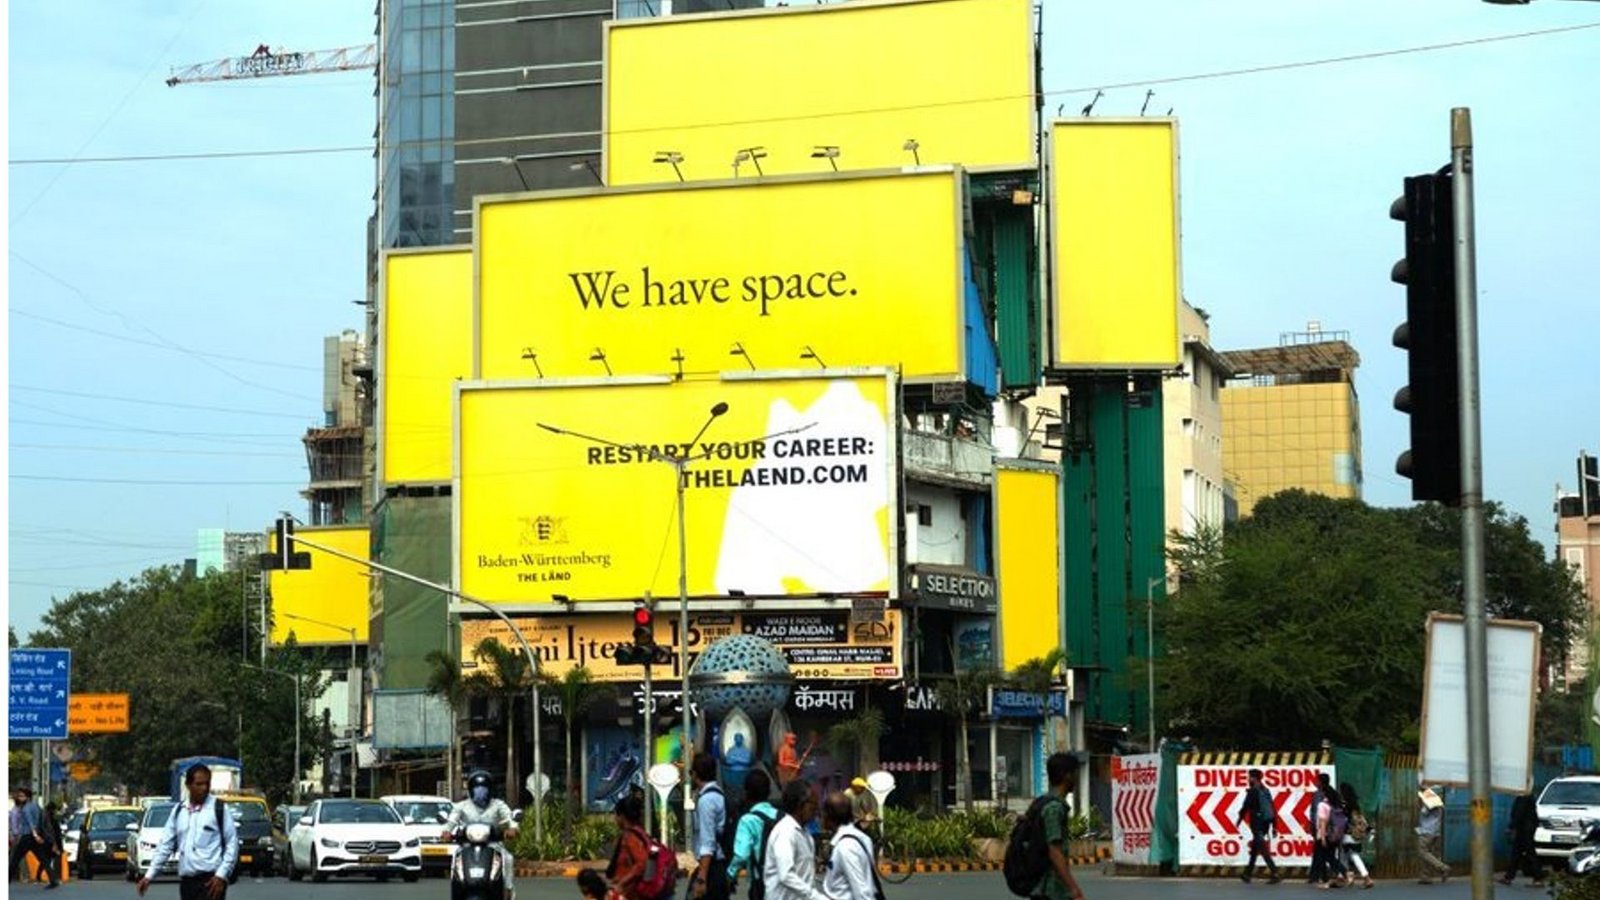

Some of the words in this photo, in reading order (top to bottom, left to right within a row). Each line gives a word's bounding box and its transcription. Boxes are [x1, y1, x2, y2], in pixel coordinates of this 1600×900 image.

[568, 270, 630, 310] We
[642, 266, 730, 307] have
[741, 271, 858, 316] space.
[587, 442, 693, 465] RESTART
[700, 441, 767, 462] YOUR
[773, 437, 875, 459] CAREER:
[680, 464, 868, 489] THELAEND.COM
[478, 551, 612, 568] Baden-Württemberg
[517, 573, 538, 583] THE
[542, 570, 572, 582] LÄND
[926, 574, 994, 597] SELECTION
[755, 626, 786, 636] AZAD
[788, 625, 834, 636] MAIDAN
[1194, 768, 1321, 788] DIVESION
[1206, 839, 1240, 856] GO
[1248, 839, 1314, 857] LOW
